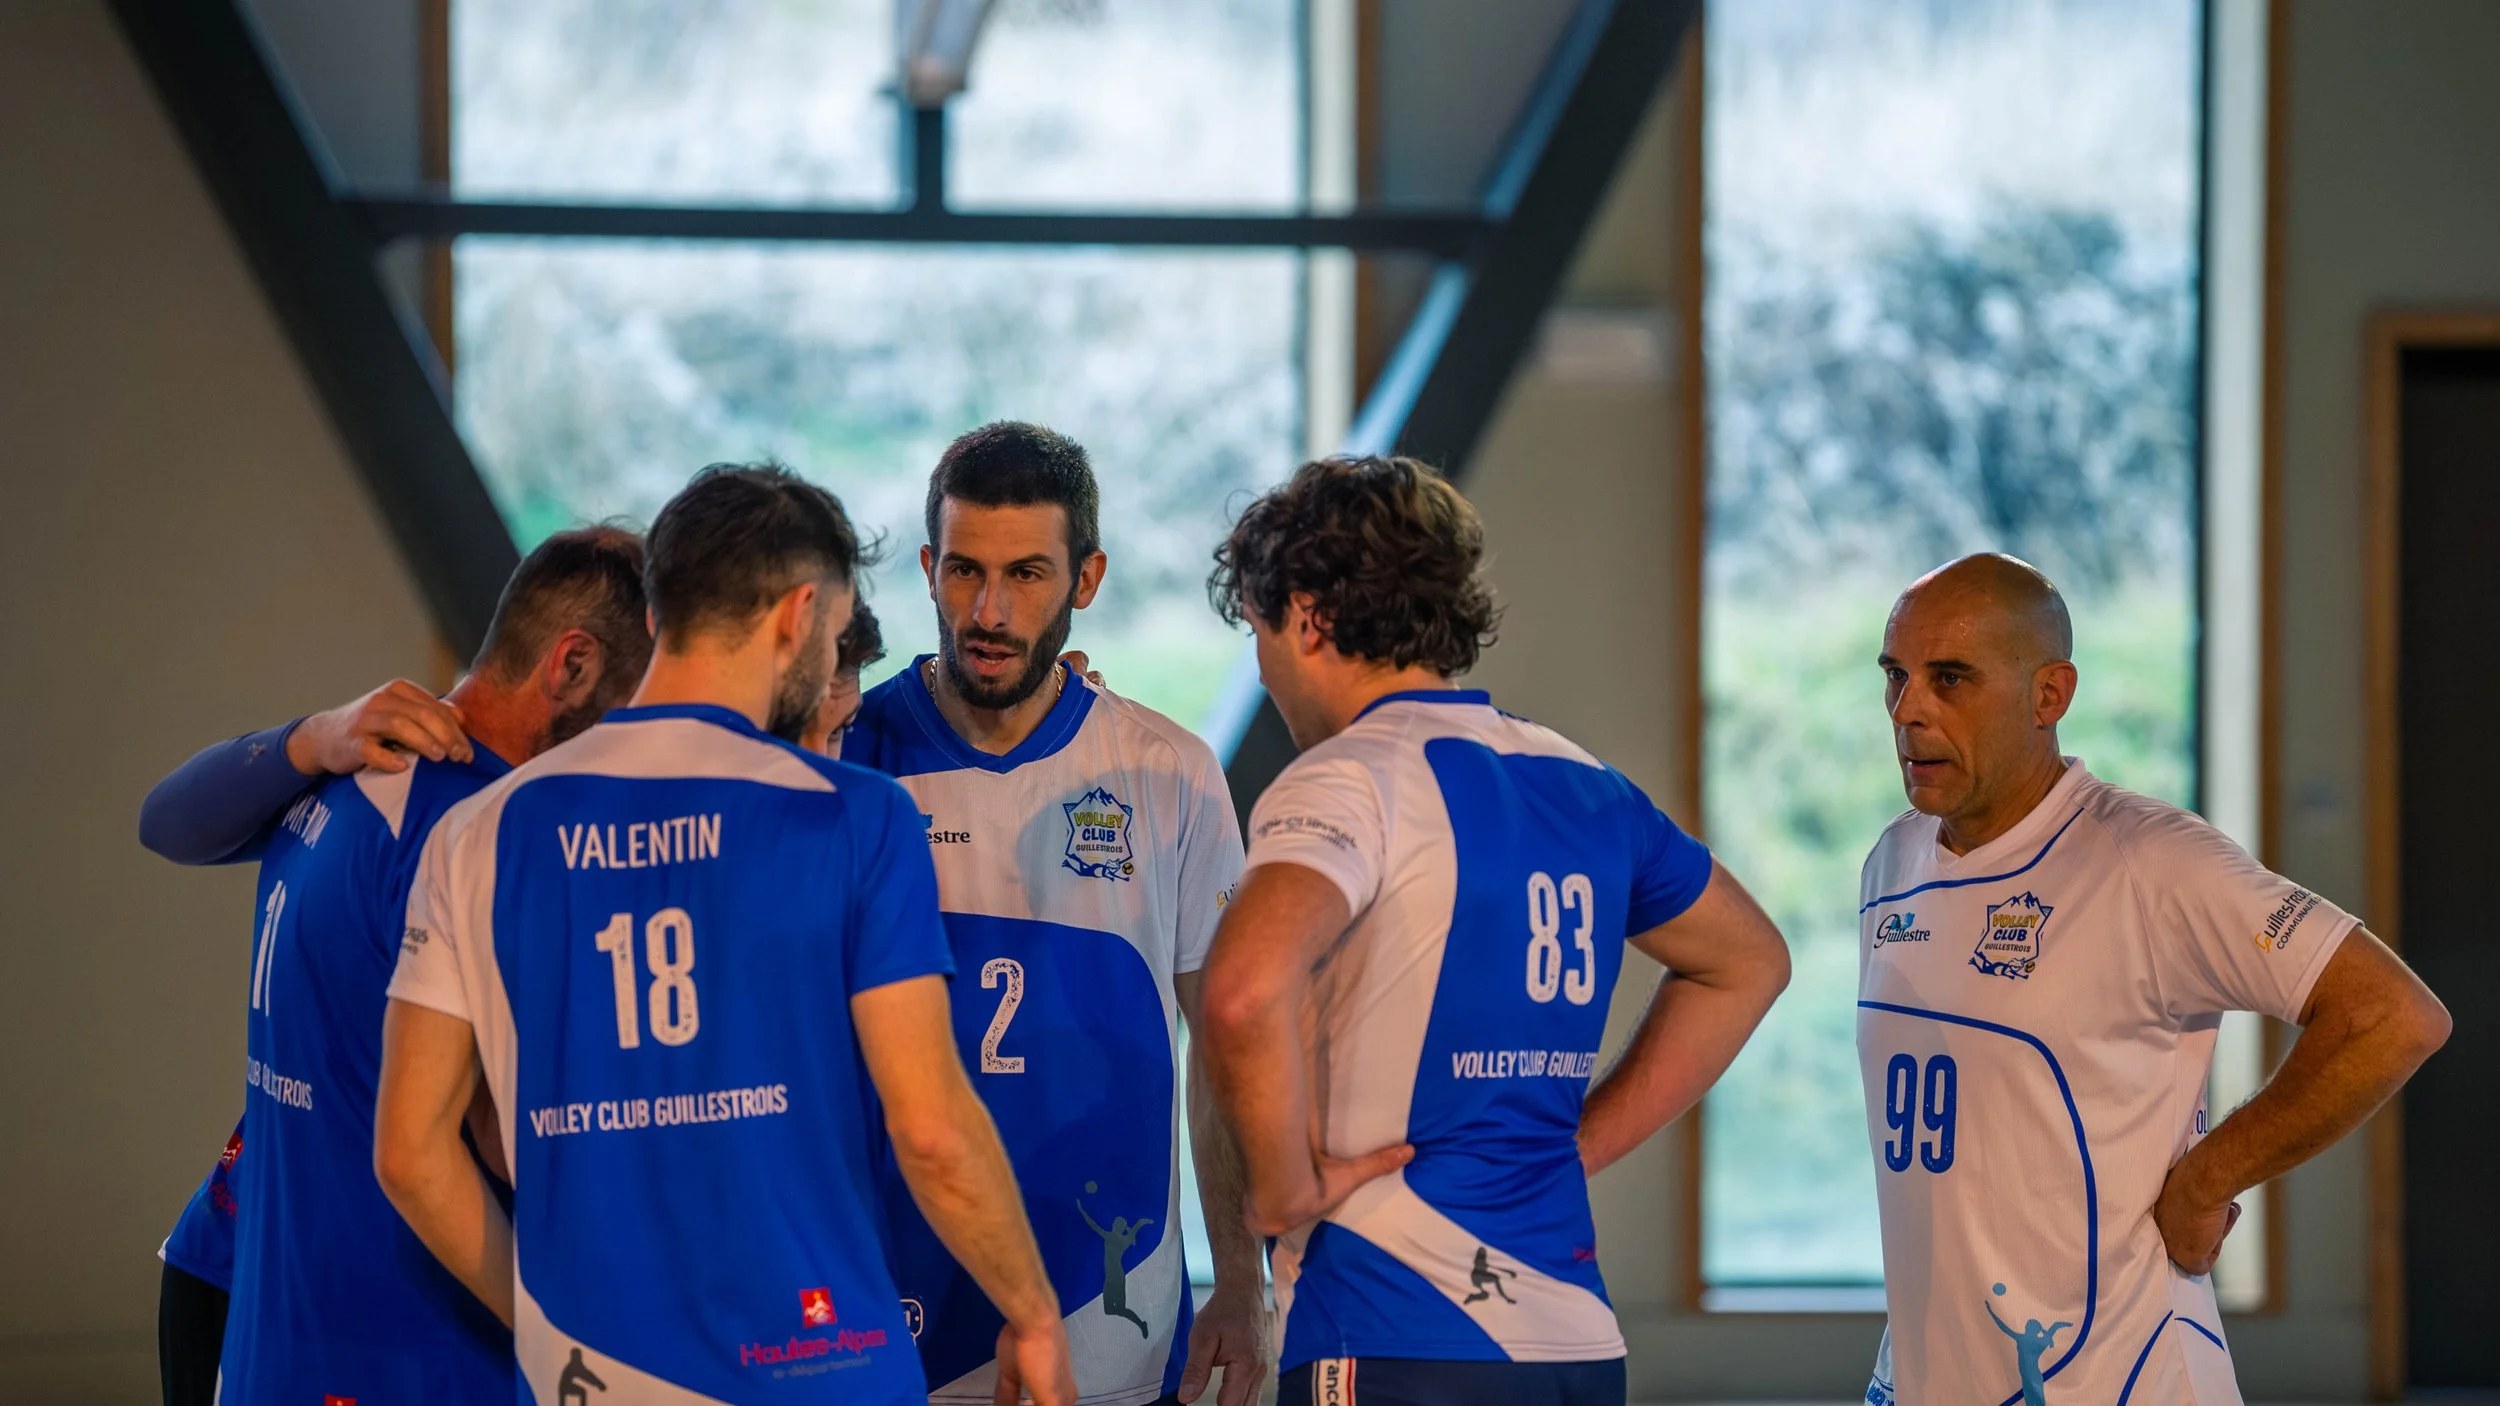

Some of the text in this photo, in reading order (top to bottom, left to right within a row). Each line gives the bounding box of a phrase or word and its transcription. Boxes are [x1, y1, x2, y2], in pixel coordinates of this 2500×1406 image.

[1073, 812, 1124, 829] VOLLEY
[1081, 828, 1116, 843] CLUB
[557, 812, 721, 870] VALENTIN
[1075, 844, 1123, 854] GUILLESTROIS
[1873, 913, 1931, 949] Guillestre
[1992, 914, 2040, 928] VOLLEY
[1993, 929, 2028, 942] CLUB
[1526, 871, 1595, 1005] 83
[1984, 943, 2032, 953] GUILLESTROIS
[595, 907, 700, 1049] 18
[981, 958, 1025, 1074] 2
[1452, 1050, 1518, 1080] VOLLEY
[1518, 1050, 1548, 1077] CLUB
[530, 1083, 789, 1138] VOLLEY CLUB GUILLESTROIS
[1885, 1053, 1958, 1174] 99
